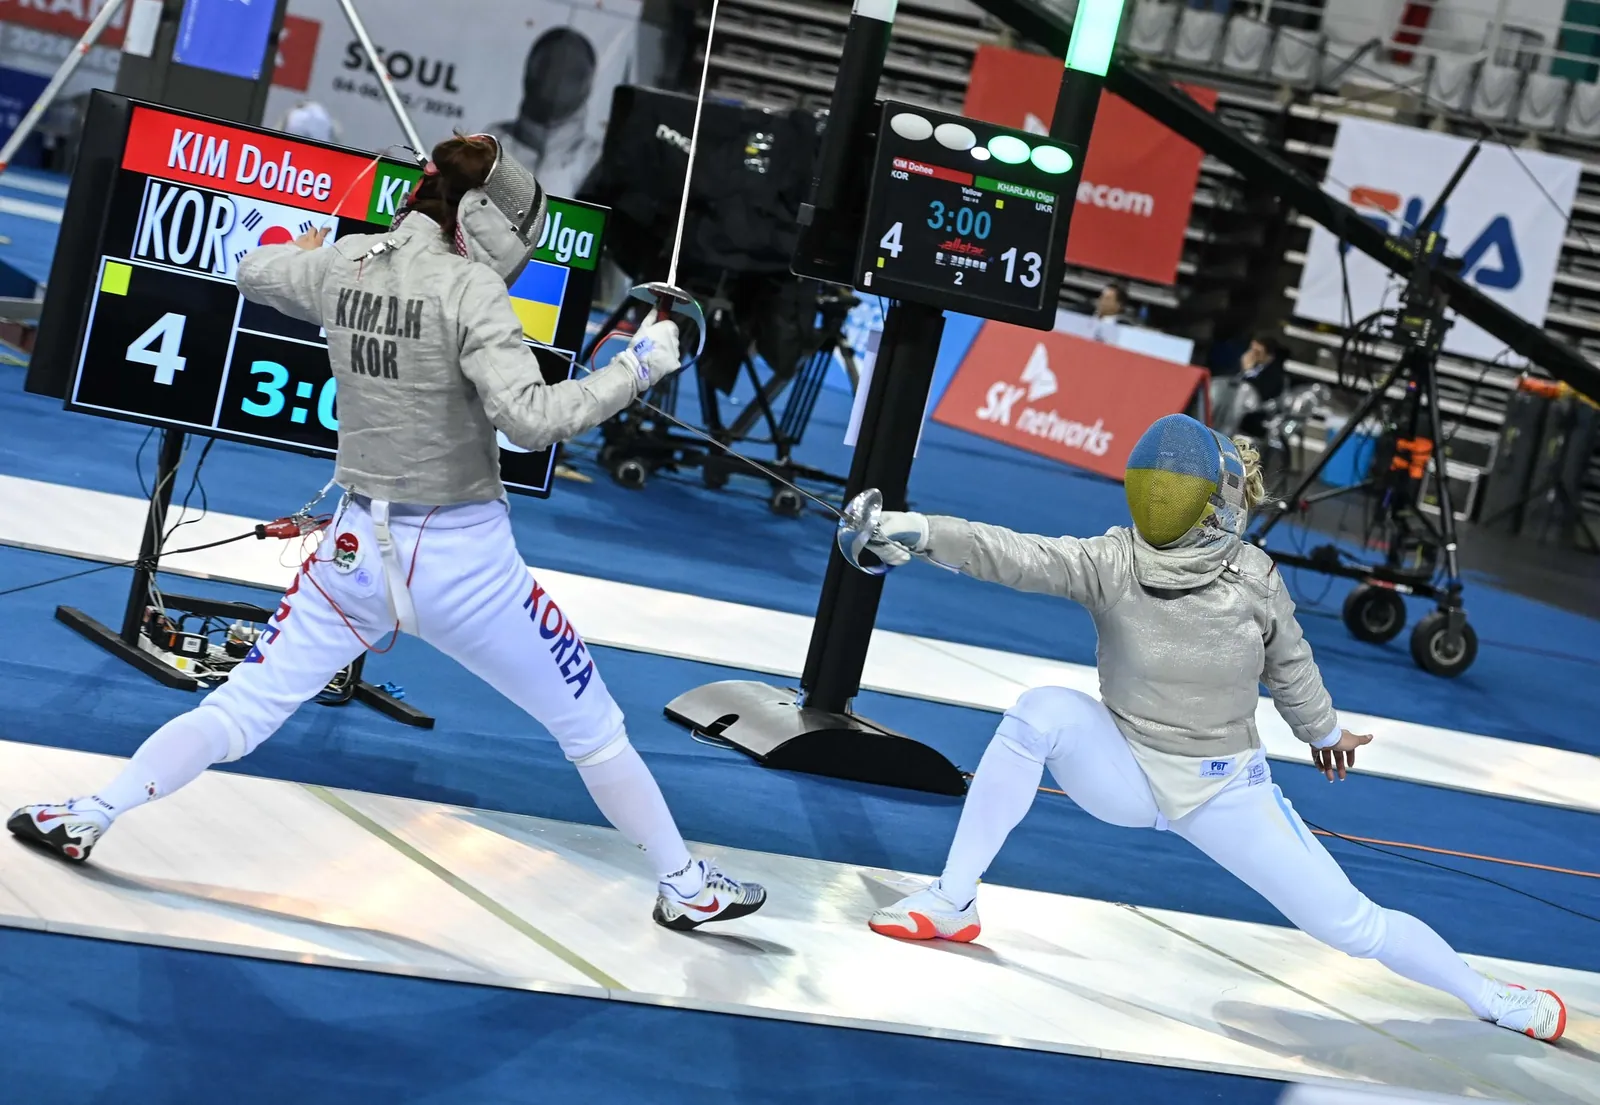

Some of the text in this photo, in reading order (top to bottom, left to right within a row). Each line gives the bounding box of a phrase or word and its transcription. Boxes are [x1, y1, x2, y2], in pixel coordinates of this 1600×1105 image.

[167, 128, 229, 179] KIM
[235, 143, 332, 201] Dohee
[891, 170, 909, 181] KOR
[893, 159, 934, 175] KIM Dohee
[961, 186, 983, 198] Yellow
[997, 182, 1055, 204] KHARLAN Olga
[1035, 202, 1053, 214] UKR
[136, 182, 236, 274] KOR
[880, 221, 904, 258] 4
[927, 200, 992, 240] 3:00
[953, 271, 964, 285] 2
[1000, 247, 1042, 288] 13
[335, 287, 424, 340] KIM.D.H
[125, 311, 187, 386] 4
[350, 333, 399, 379] KOR
[975, 380, 1114, 457] SK networks
[523, 578, 593, 700] KOREA
